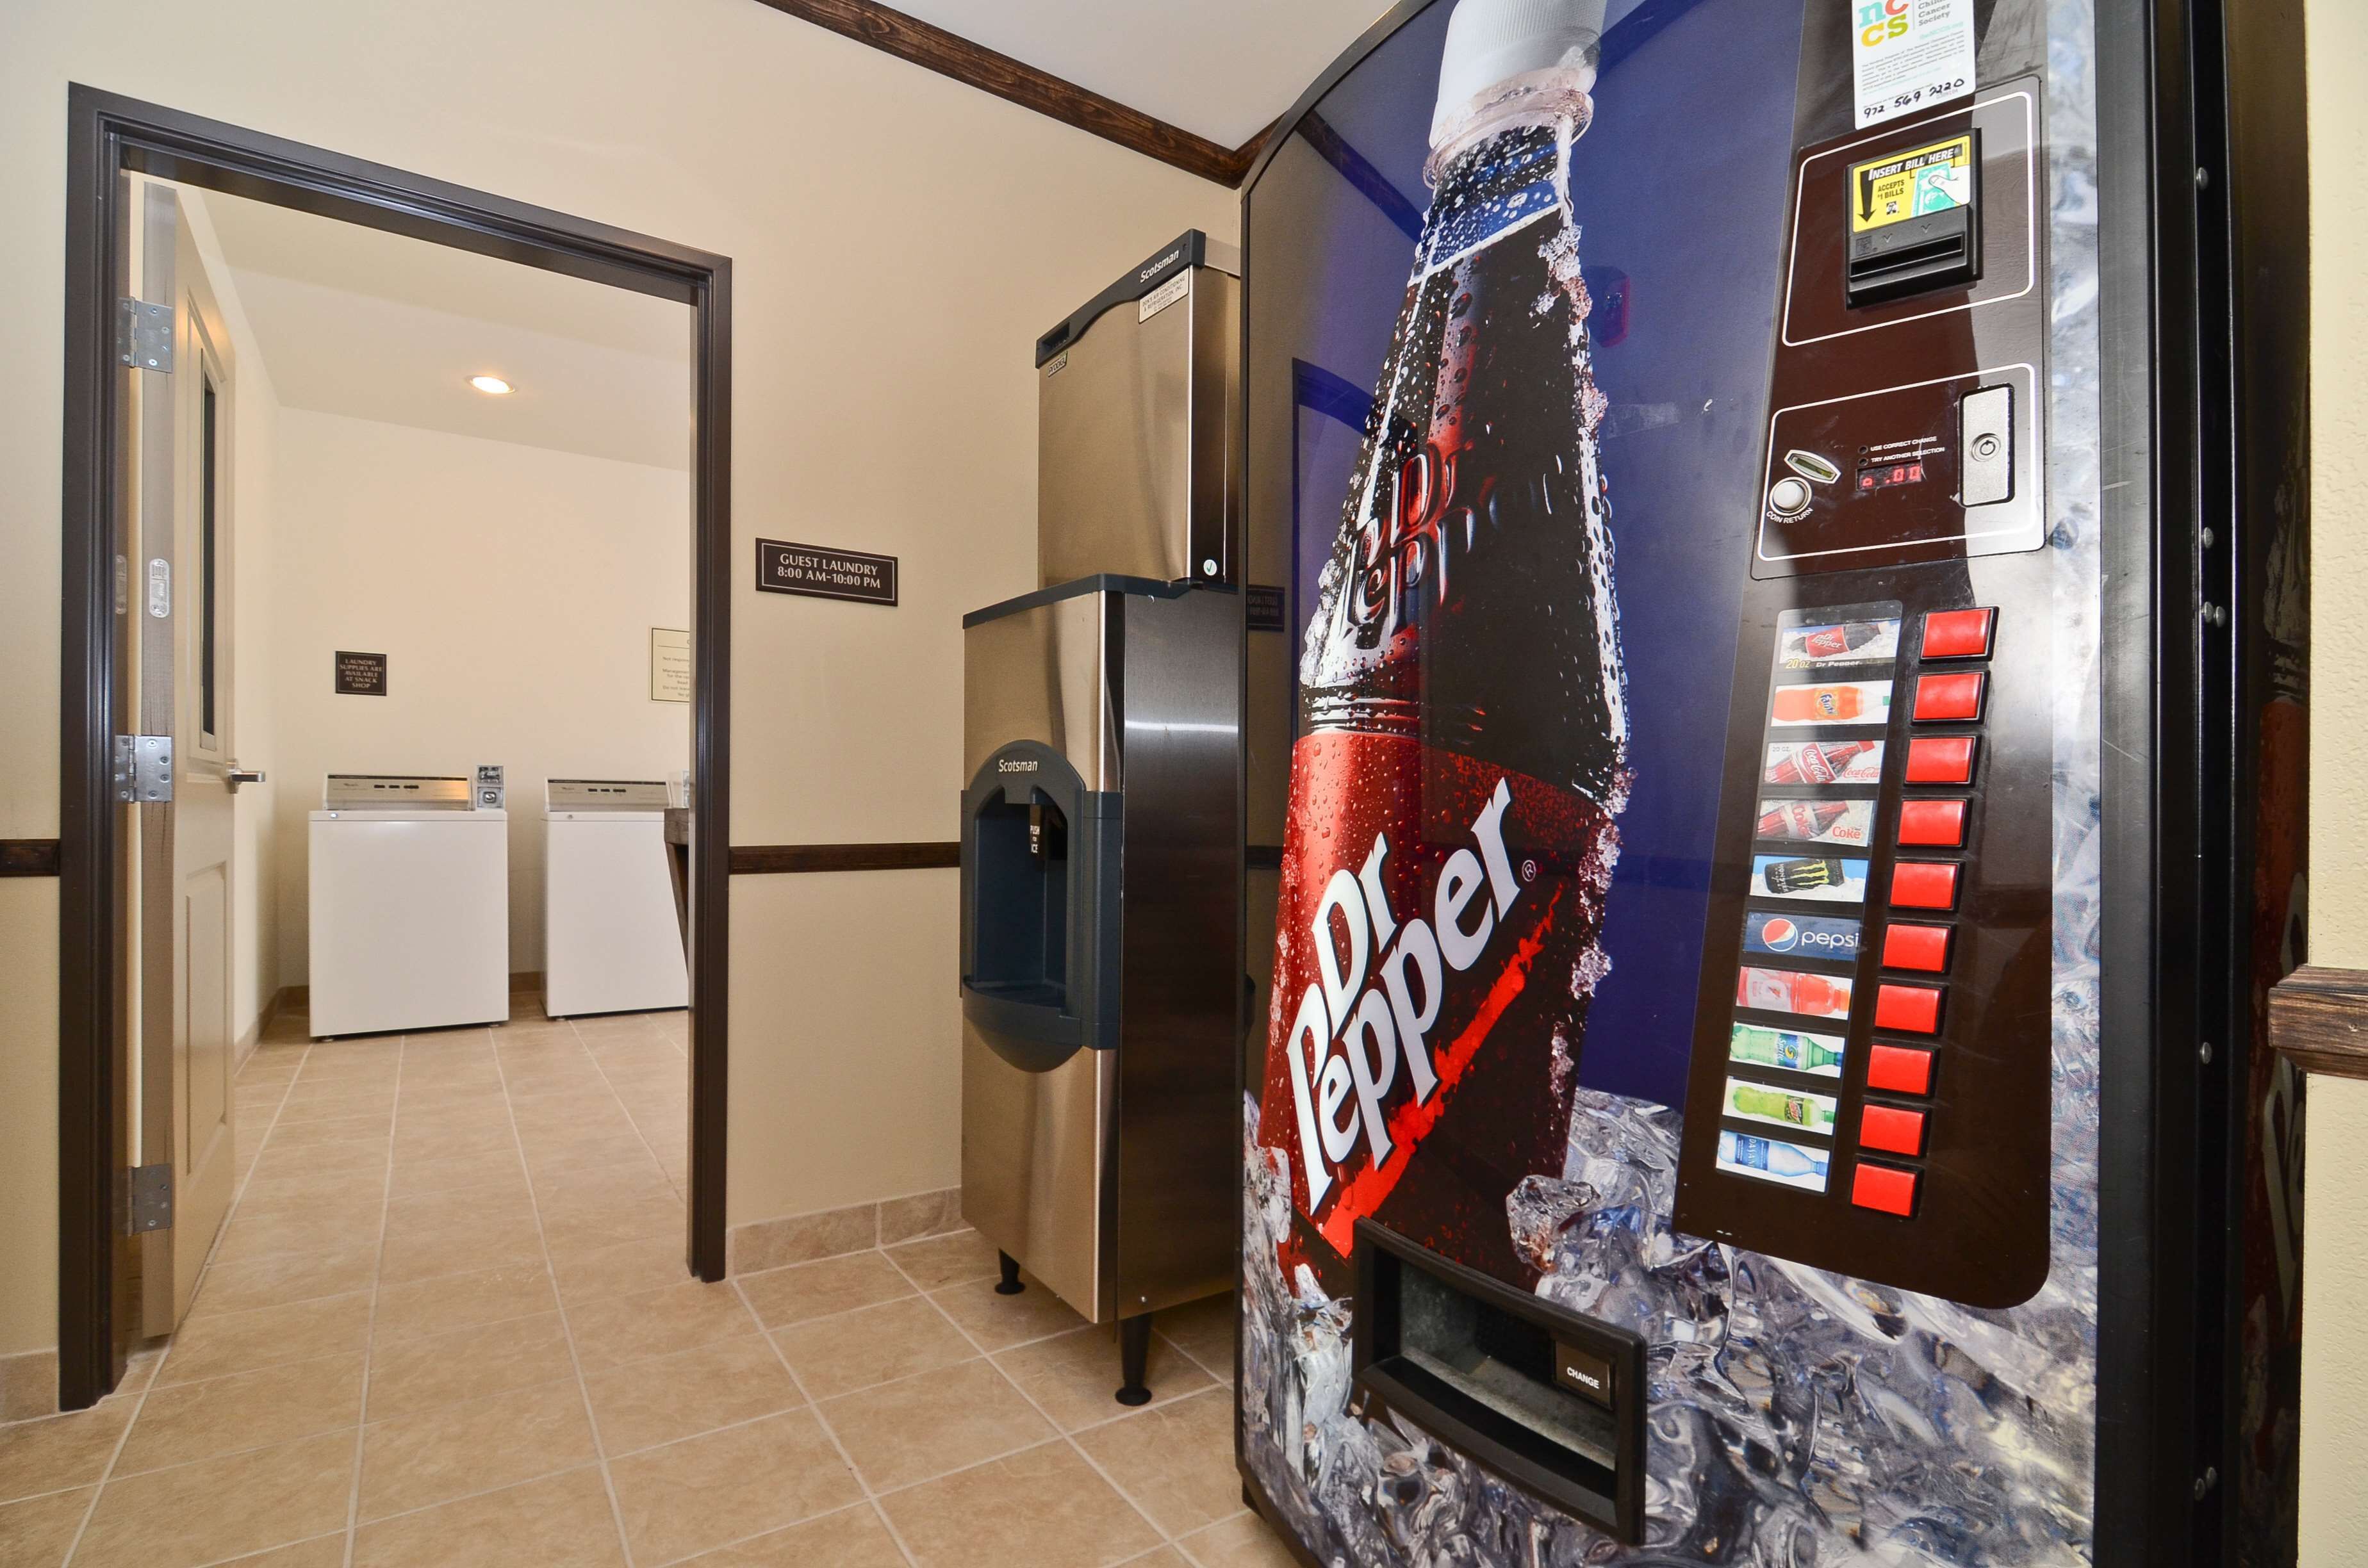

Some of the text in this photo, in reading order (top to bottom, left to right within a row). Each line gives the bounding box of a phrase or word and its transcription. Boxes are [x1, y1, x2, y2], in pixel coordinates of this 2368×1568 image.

[1918, 3, 1950, 18] Cancer
[1918, 11, 1950, 26] Society
[1864, 105, 1885, 119] 972
[1894, 90, 1921, 108] 569
[1868, 162, 1905, 181] INSERT
[1905, 156, 1925, 171] BILL
[1928, 148, 1955, 164] HERE
[1878, 179, 1905, 193] ACCEPTS
[1884, 188, 1904, 199] BILLS
[1139, 250, 1180, 283] Scotsman
[1883, 440, 1912, 449] CORRECT
[1911, 436, 1937, 445] CHANGE
[1883, 452, 1912, 461] ANOTHER
[1912, 447, 1946, 457] SELECTION
[1766, 507, 1814, 524] COIN RETURN
[780, 553, 878, 576] GUEST LAUNDRY
[777, 566, 881, 589] 8:00 AM-10:00 PM
[1785, 658, 1799, 669] 20
[998, 759, 1038, 772] Scotsman
[1832, 826, 1862, 840] Coke
[1800, 931, 1860, 949] pepsi
[1287, 776, 1522, 1217] Dr Pepper
[1777, 1038, 1787, 1061] Sprite
[1747, 1138, 1757, 1168] DASANI
[1566, 1366, 1600, 1389] CHANGE
